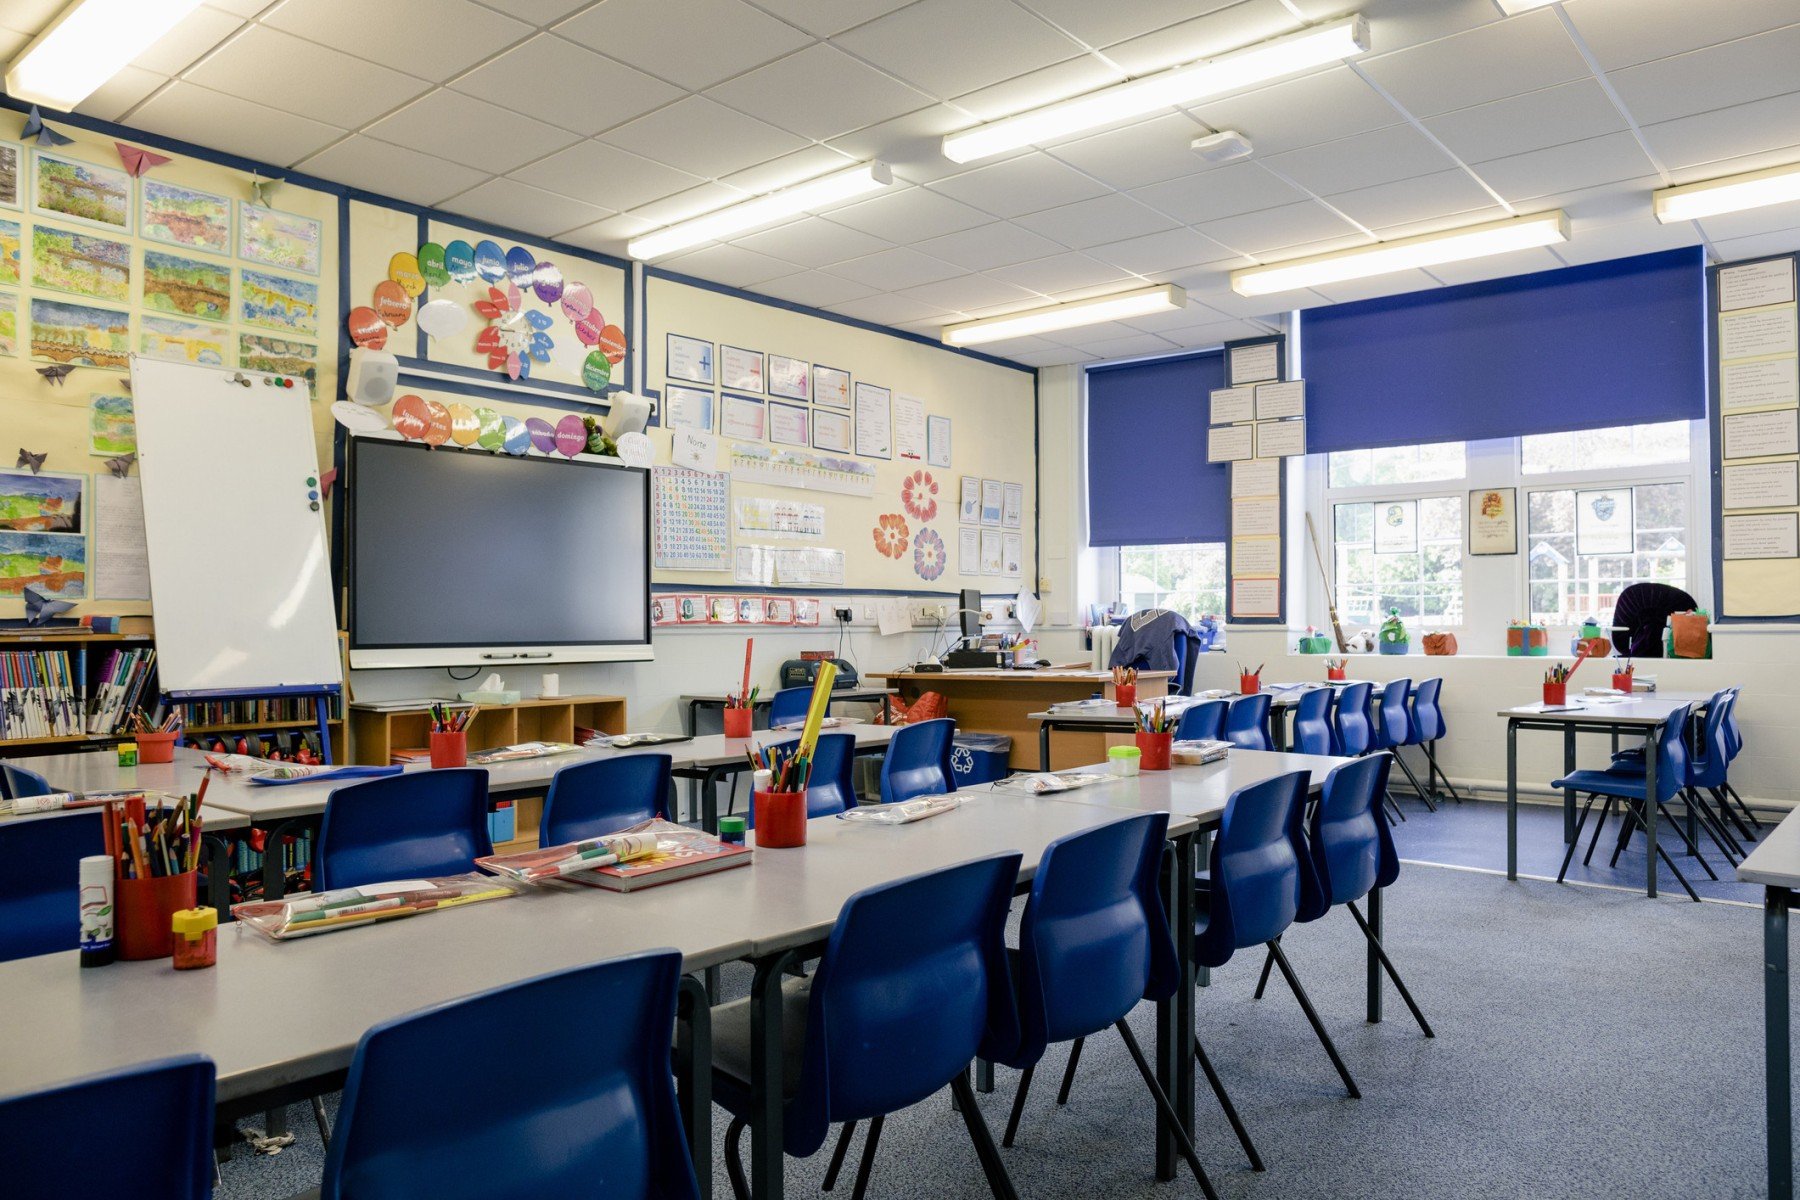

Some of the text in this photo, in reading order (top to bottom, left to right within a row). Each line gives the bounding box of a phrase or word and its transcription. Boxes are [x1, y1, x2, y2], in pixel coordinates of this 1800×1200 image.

[427, 259, 444, 270] abril
[451, 256, 473, 268] mayo
[513, 262, 529, 272] julio
[557, 431, 585, 442] domingo
[686, 434, 706, 450] Norte
[654, 606, 662, 616] R
[684, 604, 692, 615] U
